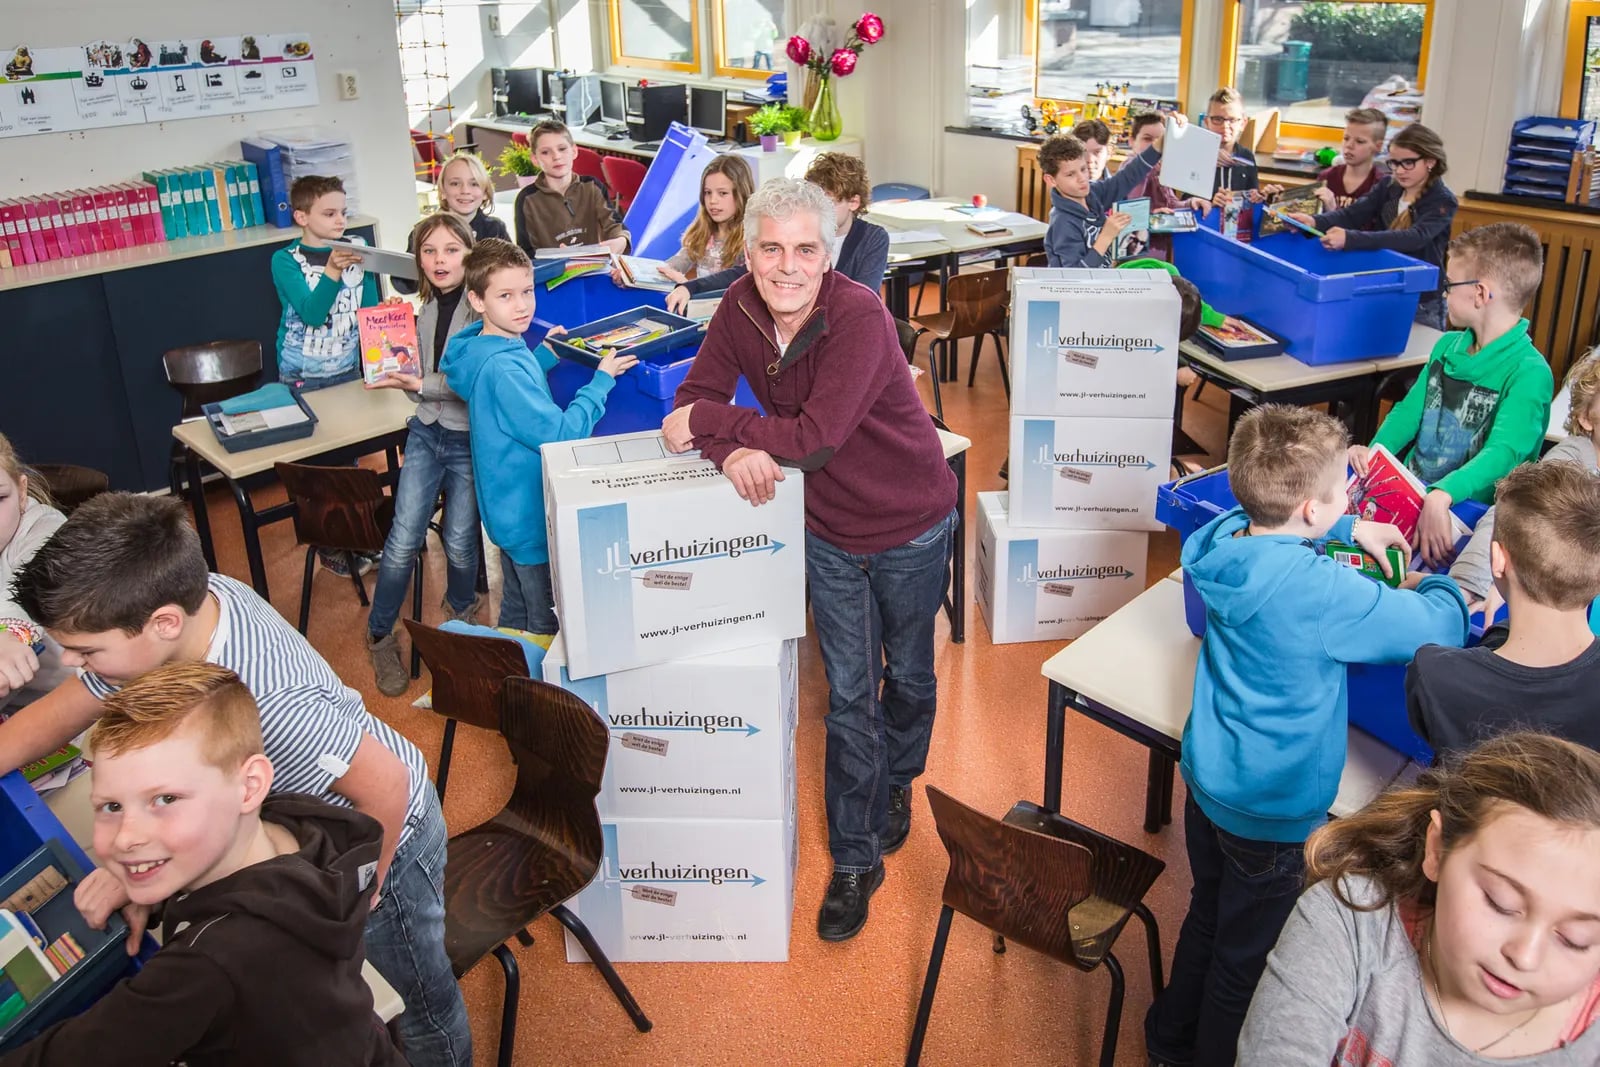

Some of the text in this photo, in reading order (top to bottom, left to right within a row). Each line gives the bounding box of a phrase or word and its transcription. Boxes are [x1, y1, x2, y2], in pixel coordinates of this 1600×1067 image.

[1058, 331, 1153, 352] verhuizingen
[1059, 391, 1146, 399] www.jl-verhuizingen.nl
[1053, 449, 1145, 468] verhuizingen
[1055, 505, 1138, 514] www.jl-verhuizingen.nl
[630, 533, 769, 565] verhuizingen
[1037, 564, 1124, 579] verhuizingen
[640, 611, 765, 639] www.jl-verhuizingen.nl
[608, 707, 743, 734] verhuizingen
[619, 785, 741, 796] www.jl-verhuizingen.nl
[619, 861, 749, 885] verhuizingen
